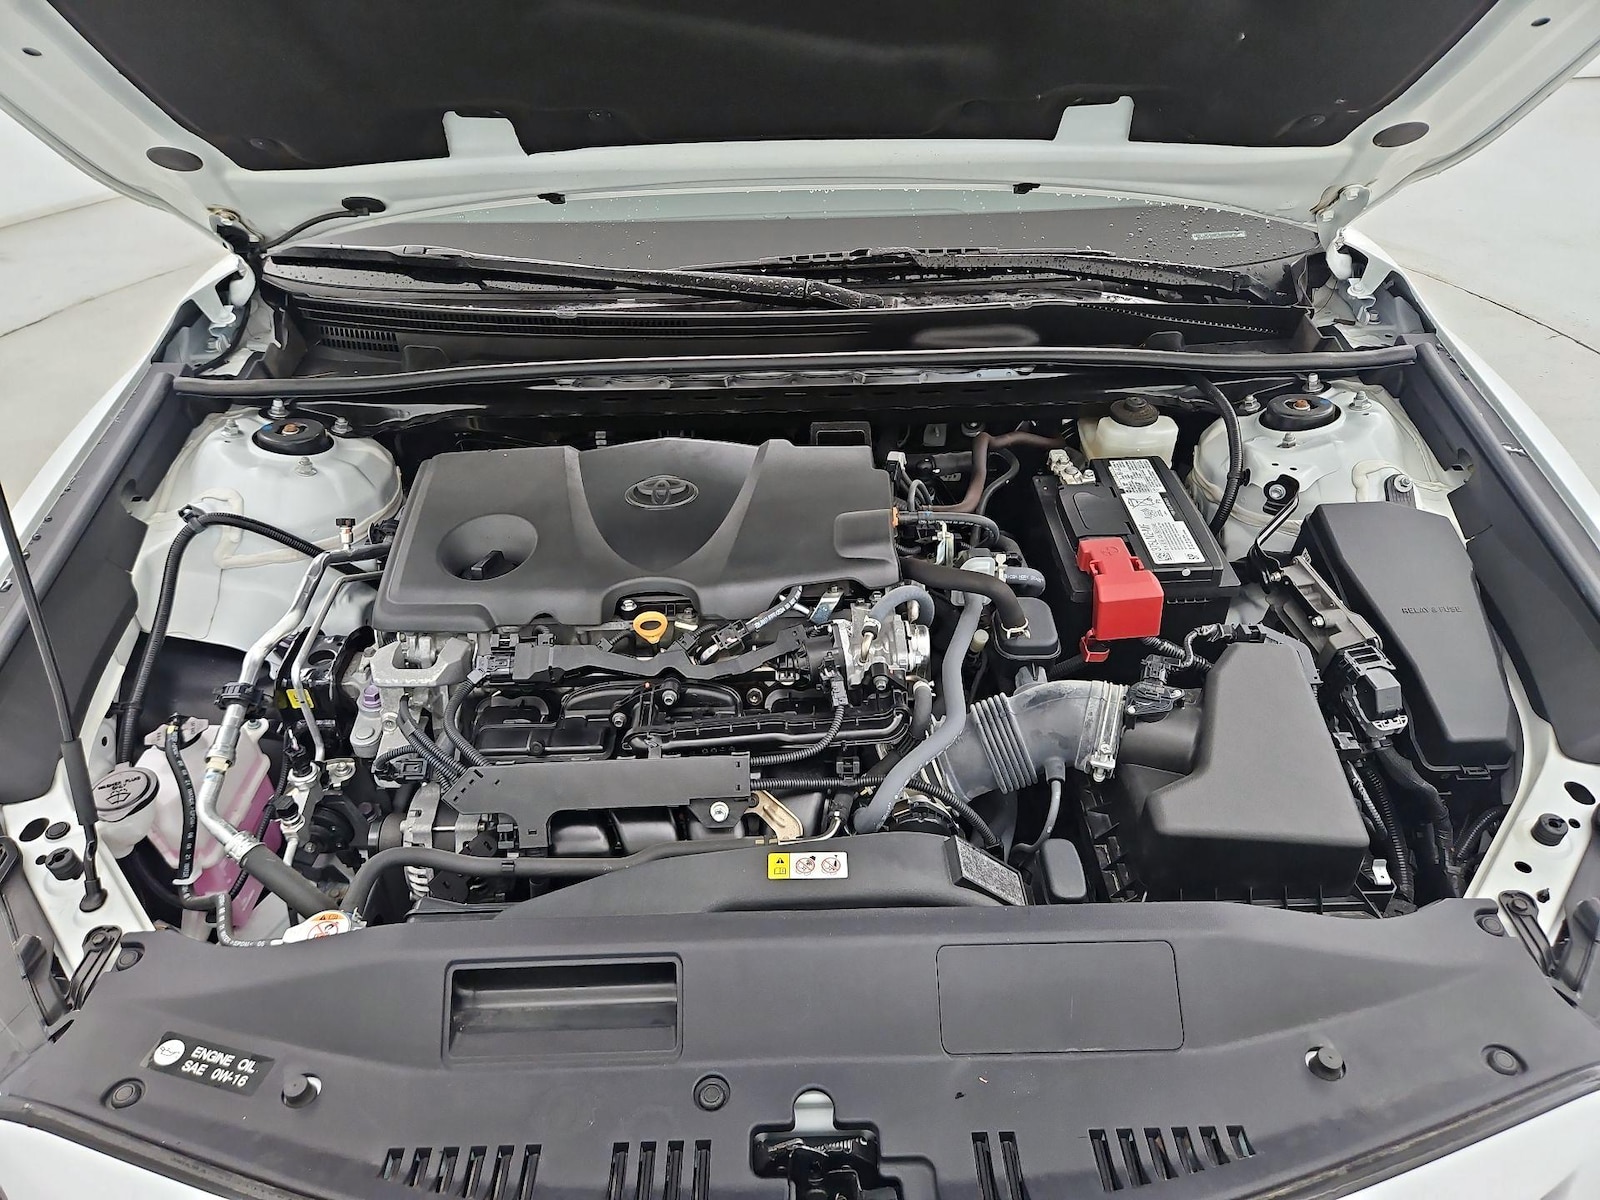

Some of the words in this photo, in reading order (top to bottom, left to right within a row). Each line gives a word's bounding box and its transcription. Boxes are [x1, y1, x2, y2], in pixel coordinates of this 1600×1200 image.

[1401, 606, 1429, 614] RELAY
[181, 1060, 209, 1076] SAE
[211, 1068, 249, 1087] 0W-16
[191, 1046, 235, 1067] ENGINE
[237, 1058, 256, 1074] OIL
